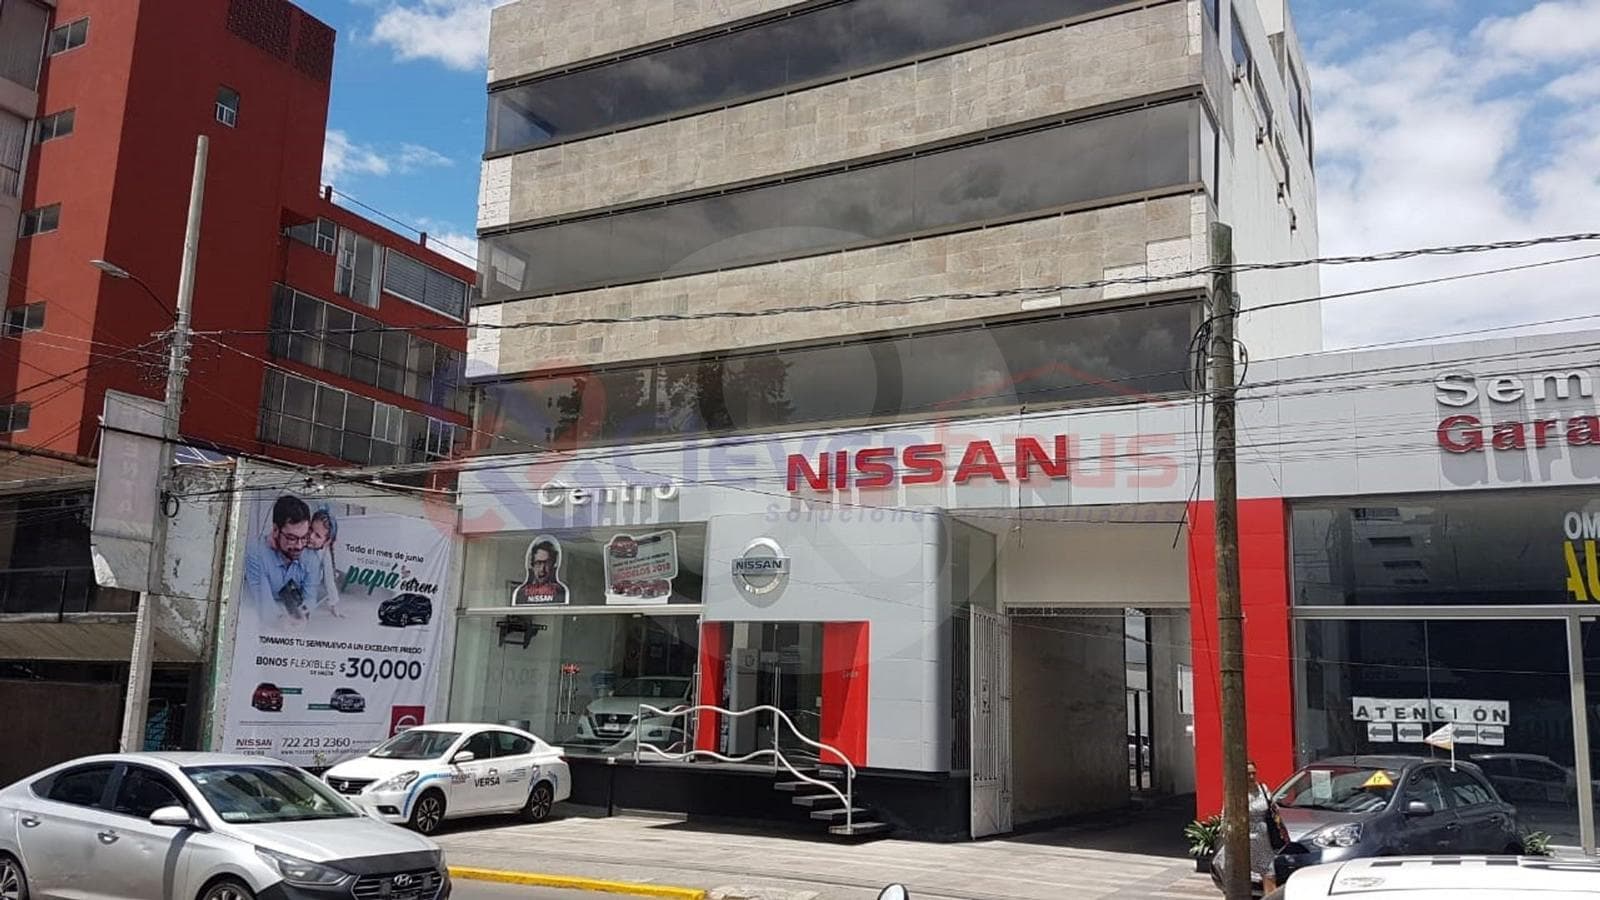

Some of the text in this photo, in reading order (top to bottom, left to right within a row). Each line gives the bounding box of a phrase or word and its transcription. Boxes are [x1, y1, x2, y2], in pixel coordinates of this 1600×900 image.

[786, 434, 1069, 492] NISSAN
[345, 543, 366, 553] Todo
[376, 550, 393, 559] mes
[394, 552, 404, 560] de
[404, 553, 424, 563] junio
[735, 559, 783, 570] NISSAN
[340, 563, 400, 596] papá
[258, 635, 294, 646] TOMAMOS
[295, 638, 305, 647] TU
[255, 656, 289, 667] BONOS
[289, 658, 337, 670] FLEXIBLES
[1356, 705, 1507, 722] ATENCIÓN
[235, 738, 273, 747] NISSAN
[281, 737, 300, 748] 722
[302, 737, 320, 748] 213
[322, 737, 351, 748] 2360
[474, 776, 501, 788] VERSA
